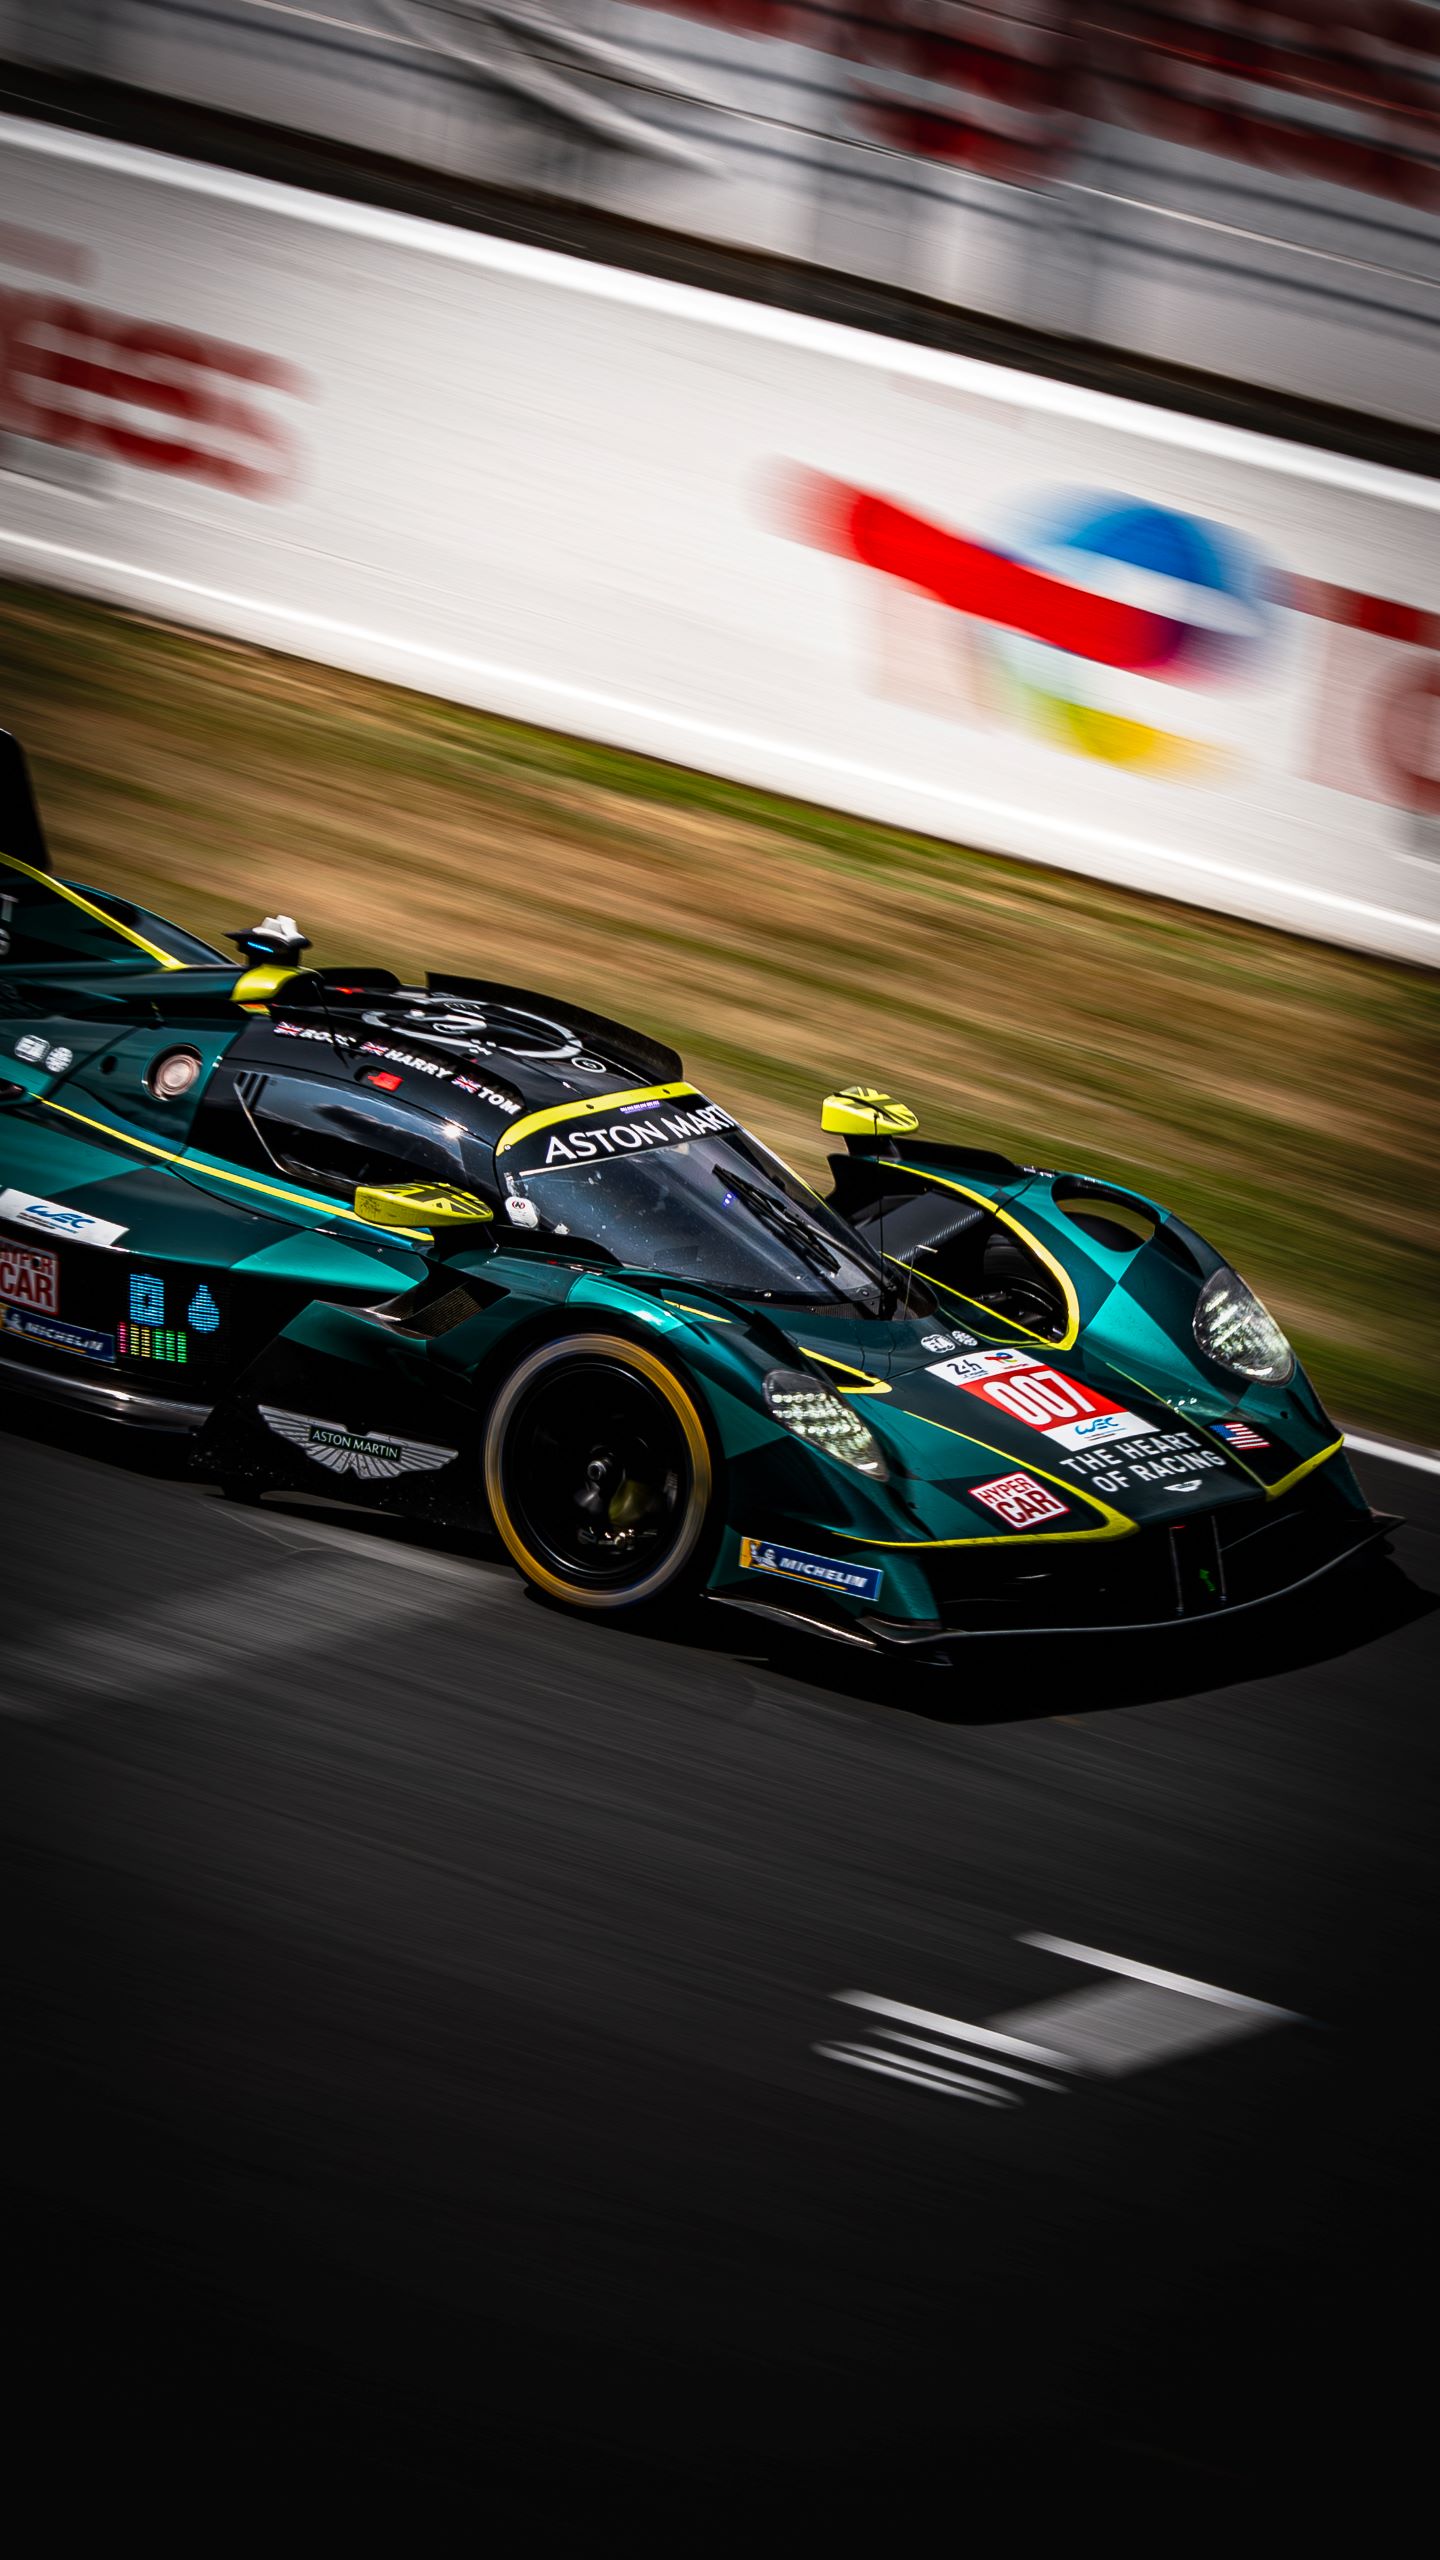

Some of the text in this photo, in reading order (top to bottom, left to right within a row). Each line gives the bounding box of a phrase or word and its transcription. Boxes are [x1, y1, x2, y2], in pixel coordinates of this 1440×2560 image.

[384, 1049, 454, 1079] HARRY
[477, 1086, 522, 1116] TOM
[545, 1120, 669, 1164] ASTON
[24, 1204, 97, 1229] WEC
[0, 1261, 54, 1307] CAR
[25, 1322, 104, 1351] MICHELIN
[982, 1370, 1097, 1426] 007
[1074, 1416, 1119, 1435] WEC
[312, 1430, 399, 1459] ASTON MARTIN
[1059, 1448, 1124, 1475] THE
[1114, 1432, 1203, 1460] HEART
[1092, 1450, 1227, 1492] OF RACING
[977, 1477, 1038, 1504] HYPER
[995, 1490, 1062, 1523] CAR
[780, 1557, 868, 1588] MICHELIN
